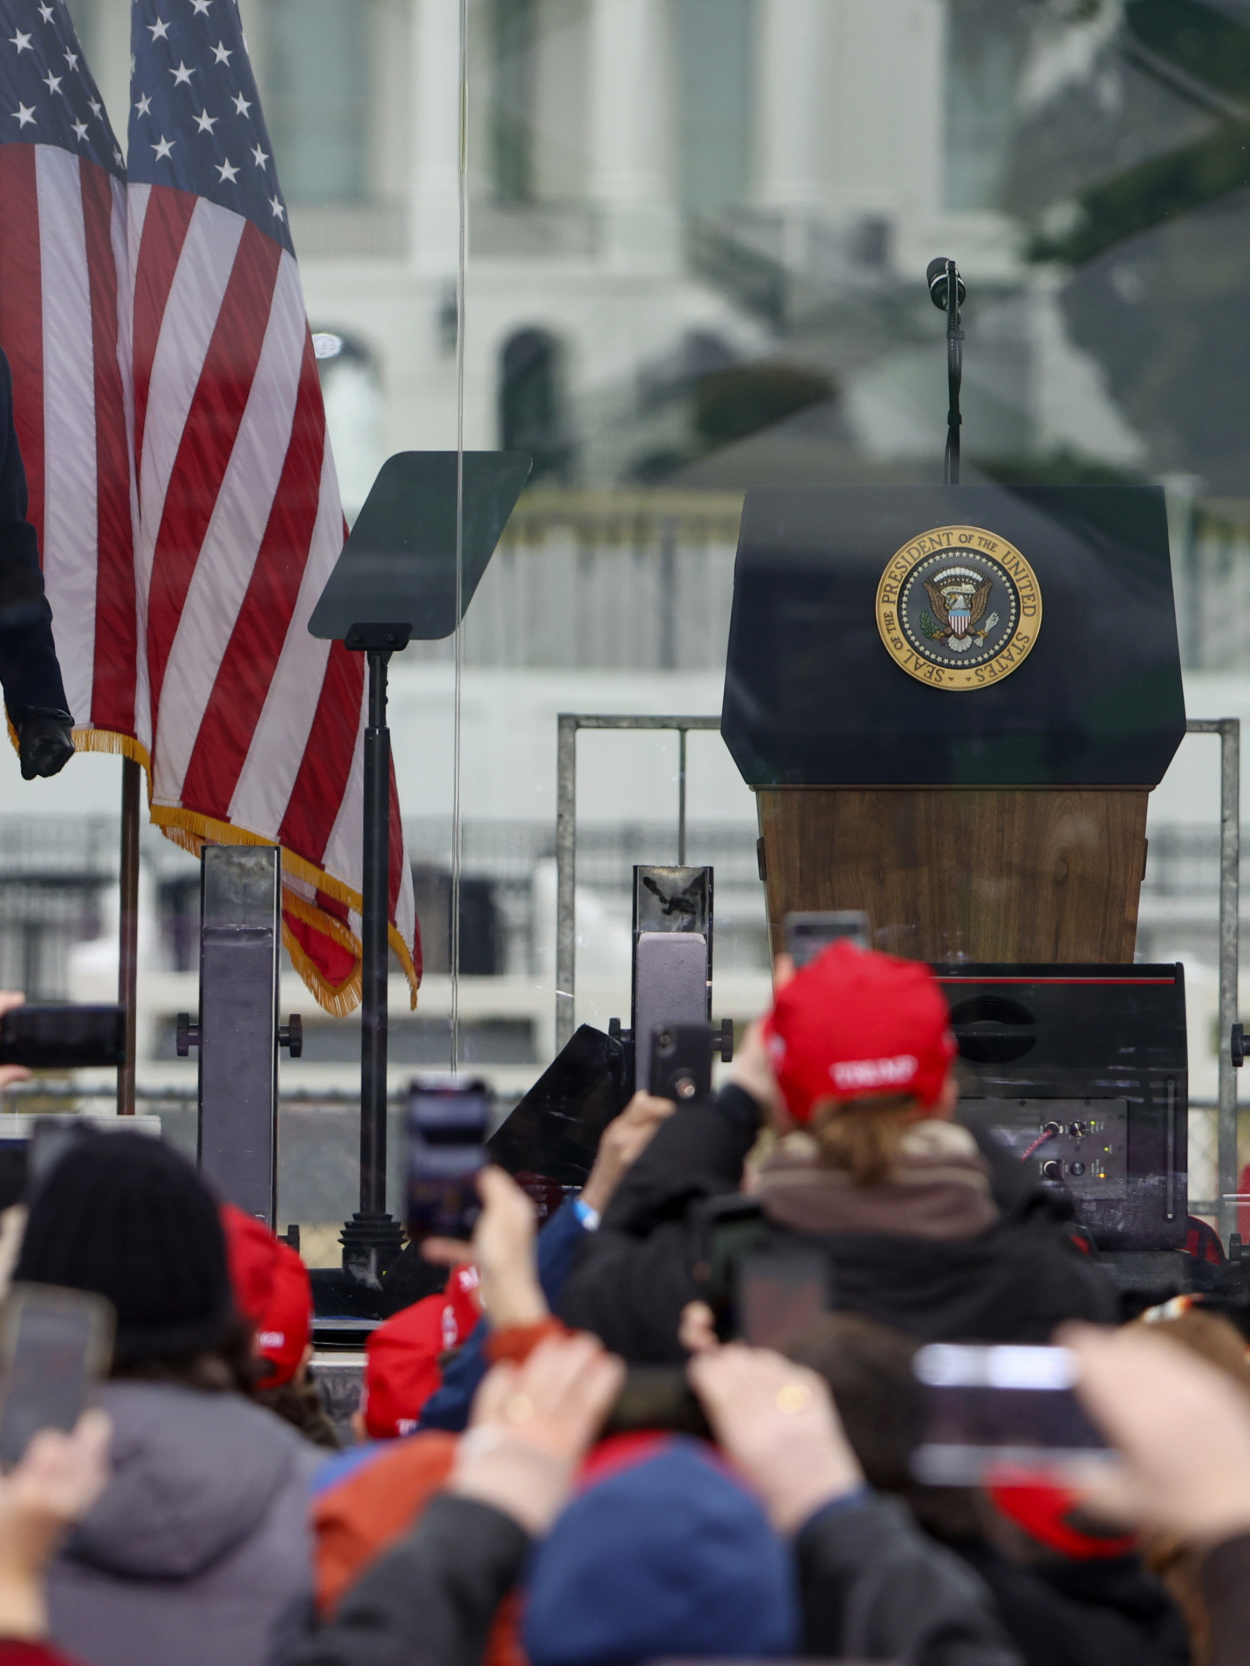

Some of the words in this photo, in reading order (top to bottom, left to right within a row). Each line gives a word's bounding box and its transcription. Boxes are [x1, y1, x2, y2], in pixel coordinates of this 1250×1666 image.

[958, 533, 974, 544] OF
[978, 537, 998, 553] THE
[882, 532, 954, 605] PRESIDENT
[1001, 550, 1037, 617] UNITED
[883, 611, 897, 634] THE
[890, 636, 904, 651] OF
[903, 653, 945, 683] SEAL
[974, 631, 1030, 683] STATES
